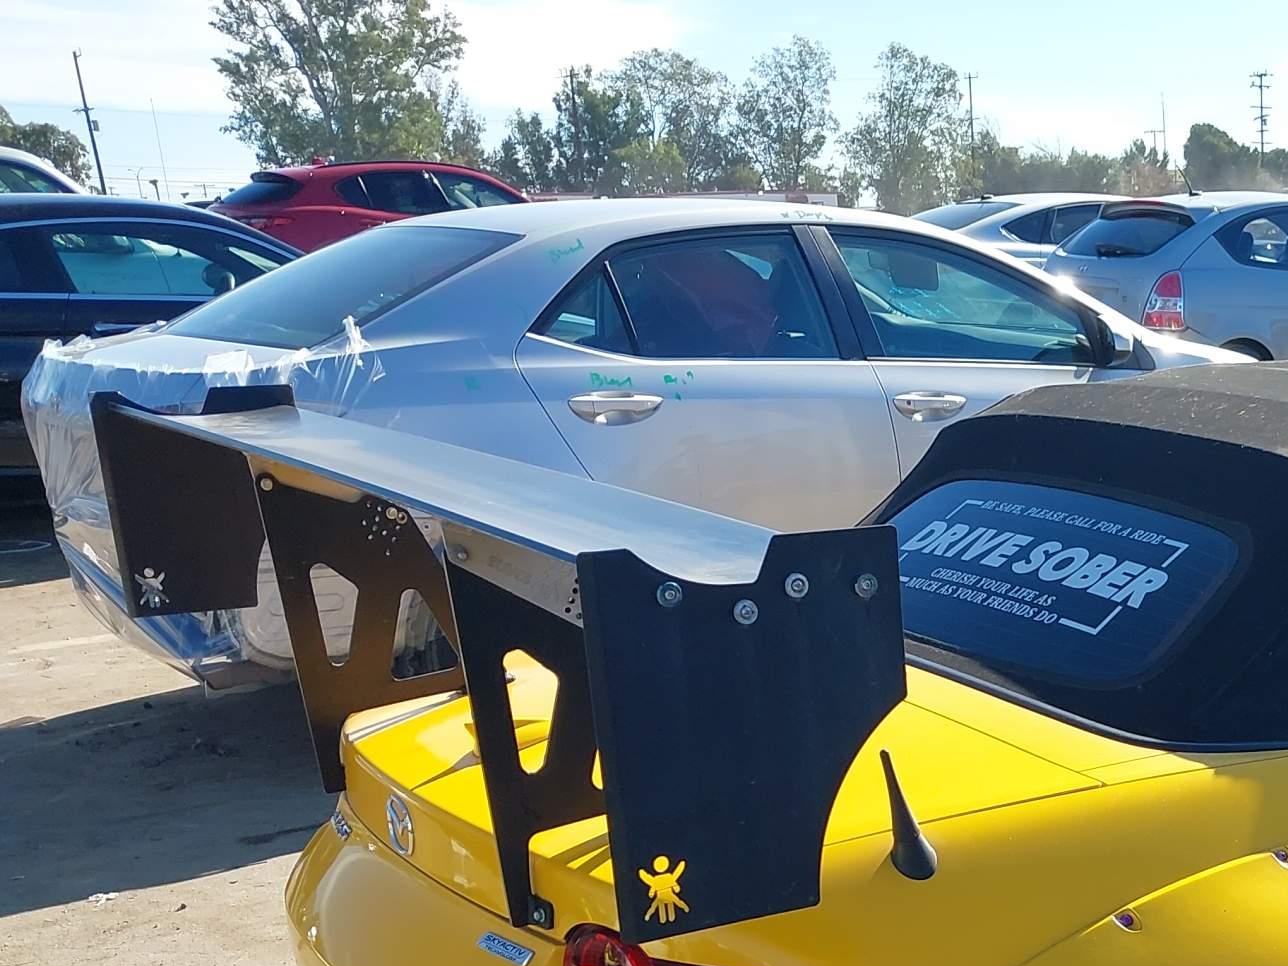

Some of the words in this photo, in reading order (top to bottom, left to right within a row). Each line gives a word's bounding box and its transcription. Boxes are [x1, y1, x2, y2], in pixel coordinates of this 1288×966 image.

[980, 500, 997, 510] BE
[1023, 508, 1065, 522] PLEASE
[1065, 514, 1095, 529] CALL
[1094, 520, 1121, 535] FOR
[1117, 527, 1132, 537] A
[1129, 529, 1166, 545] RIDE
[900, 520, 1034, 568] DRIVE
[1012, 541, 1168, 609] SOBER
[930, 567, 978, 585] CHERISH
[976, 578, 1011, 595] YOUR
[1007, 586, 1039, 602] LIFE
[1033, 594, 1056, 607] AS
[905, 577, 940, 593] MUCH
[938, 583, 957, 596] AS
[954, 587, 988, 604] YOUR
[983, 595, 1038, 619] FRIENDS
[1033, 609, 1058, 624] DO
[484, 934, 526, 955] SKYACTIV
